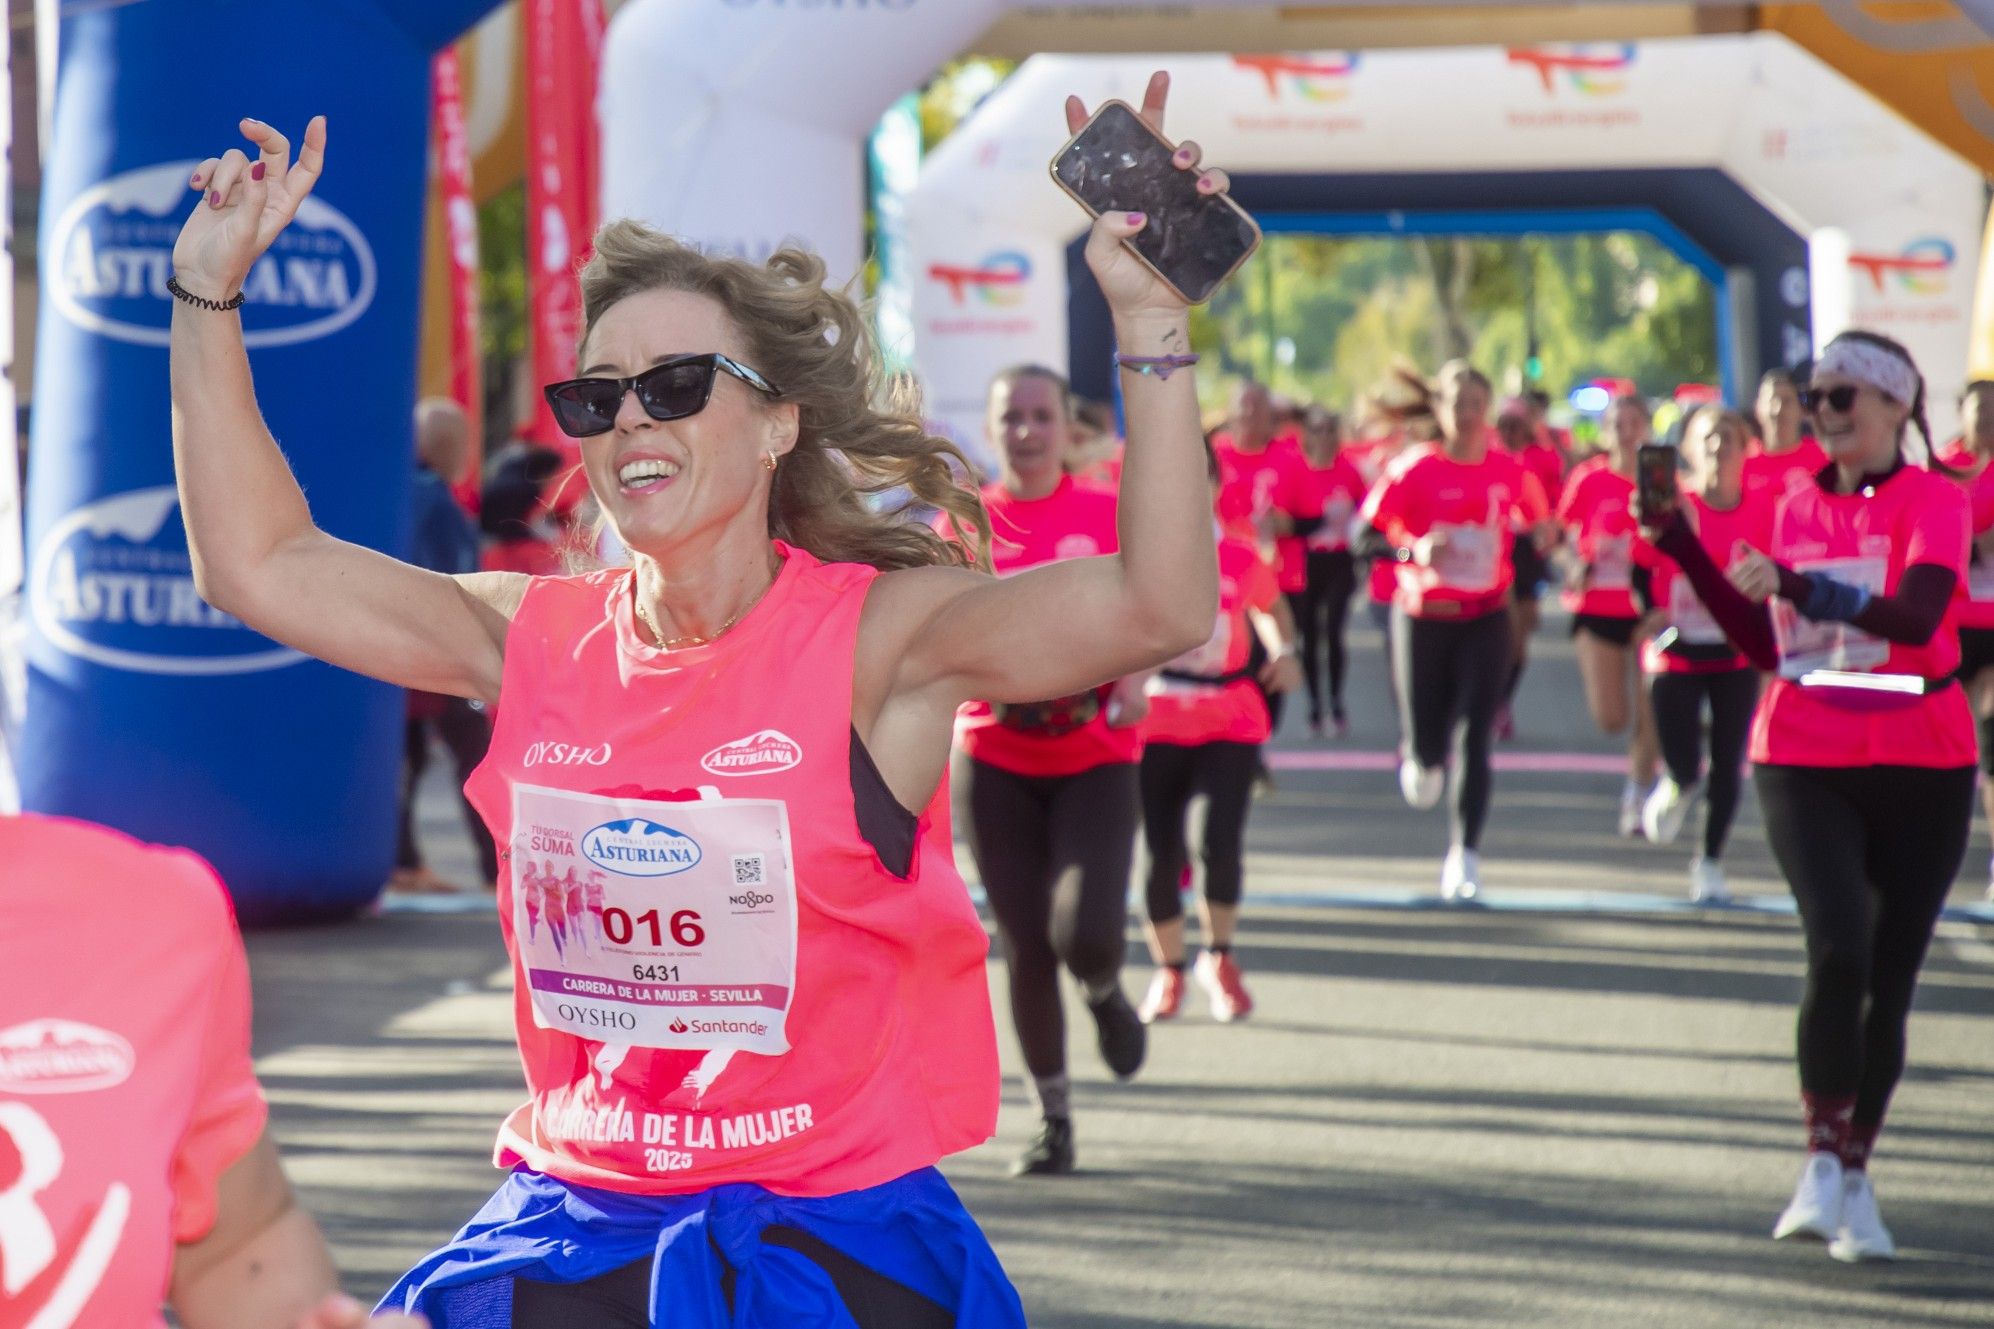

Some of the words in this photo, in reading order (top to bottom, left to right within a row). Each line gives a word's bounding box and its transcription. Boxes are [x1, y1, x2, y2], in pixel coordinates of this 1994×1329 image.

[61, 222, 351, 307] ASTUANA
[523, 741, 612, 767] OYSHO
[707, 749, 794, 767] ASTURIANA
[530, 825, 543, 835] TU
[544, 827, 575, 840] DORSAL
[530, 836, 576, 857] SUMA
[591, 836, 693, 863] ASTURIANA
[602, 907, 705, 947] 016
[633, 964, 680, 982] 6431
[562, 978, 615, 996] CARRERA
[618, 985, 633, 998] DE
[635, 988, 651, 1001] LA
[654, 989, 698, 1002] MUJER
[709, 990, 763, 1002] SEVILLA
[558, 1003, 636, 1031] OYSHO
[691, 1019, 768, 1036] Santander
[643, 1112, 678, 1147] DE
[685, 1115, 716, 1150] LA
[721, 1103, 814, 1150] MUJER
[644, 1148, 693, 1172] 2025
